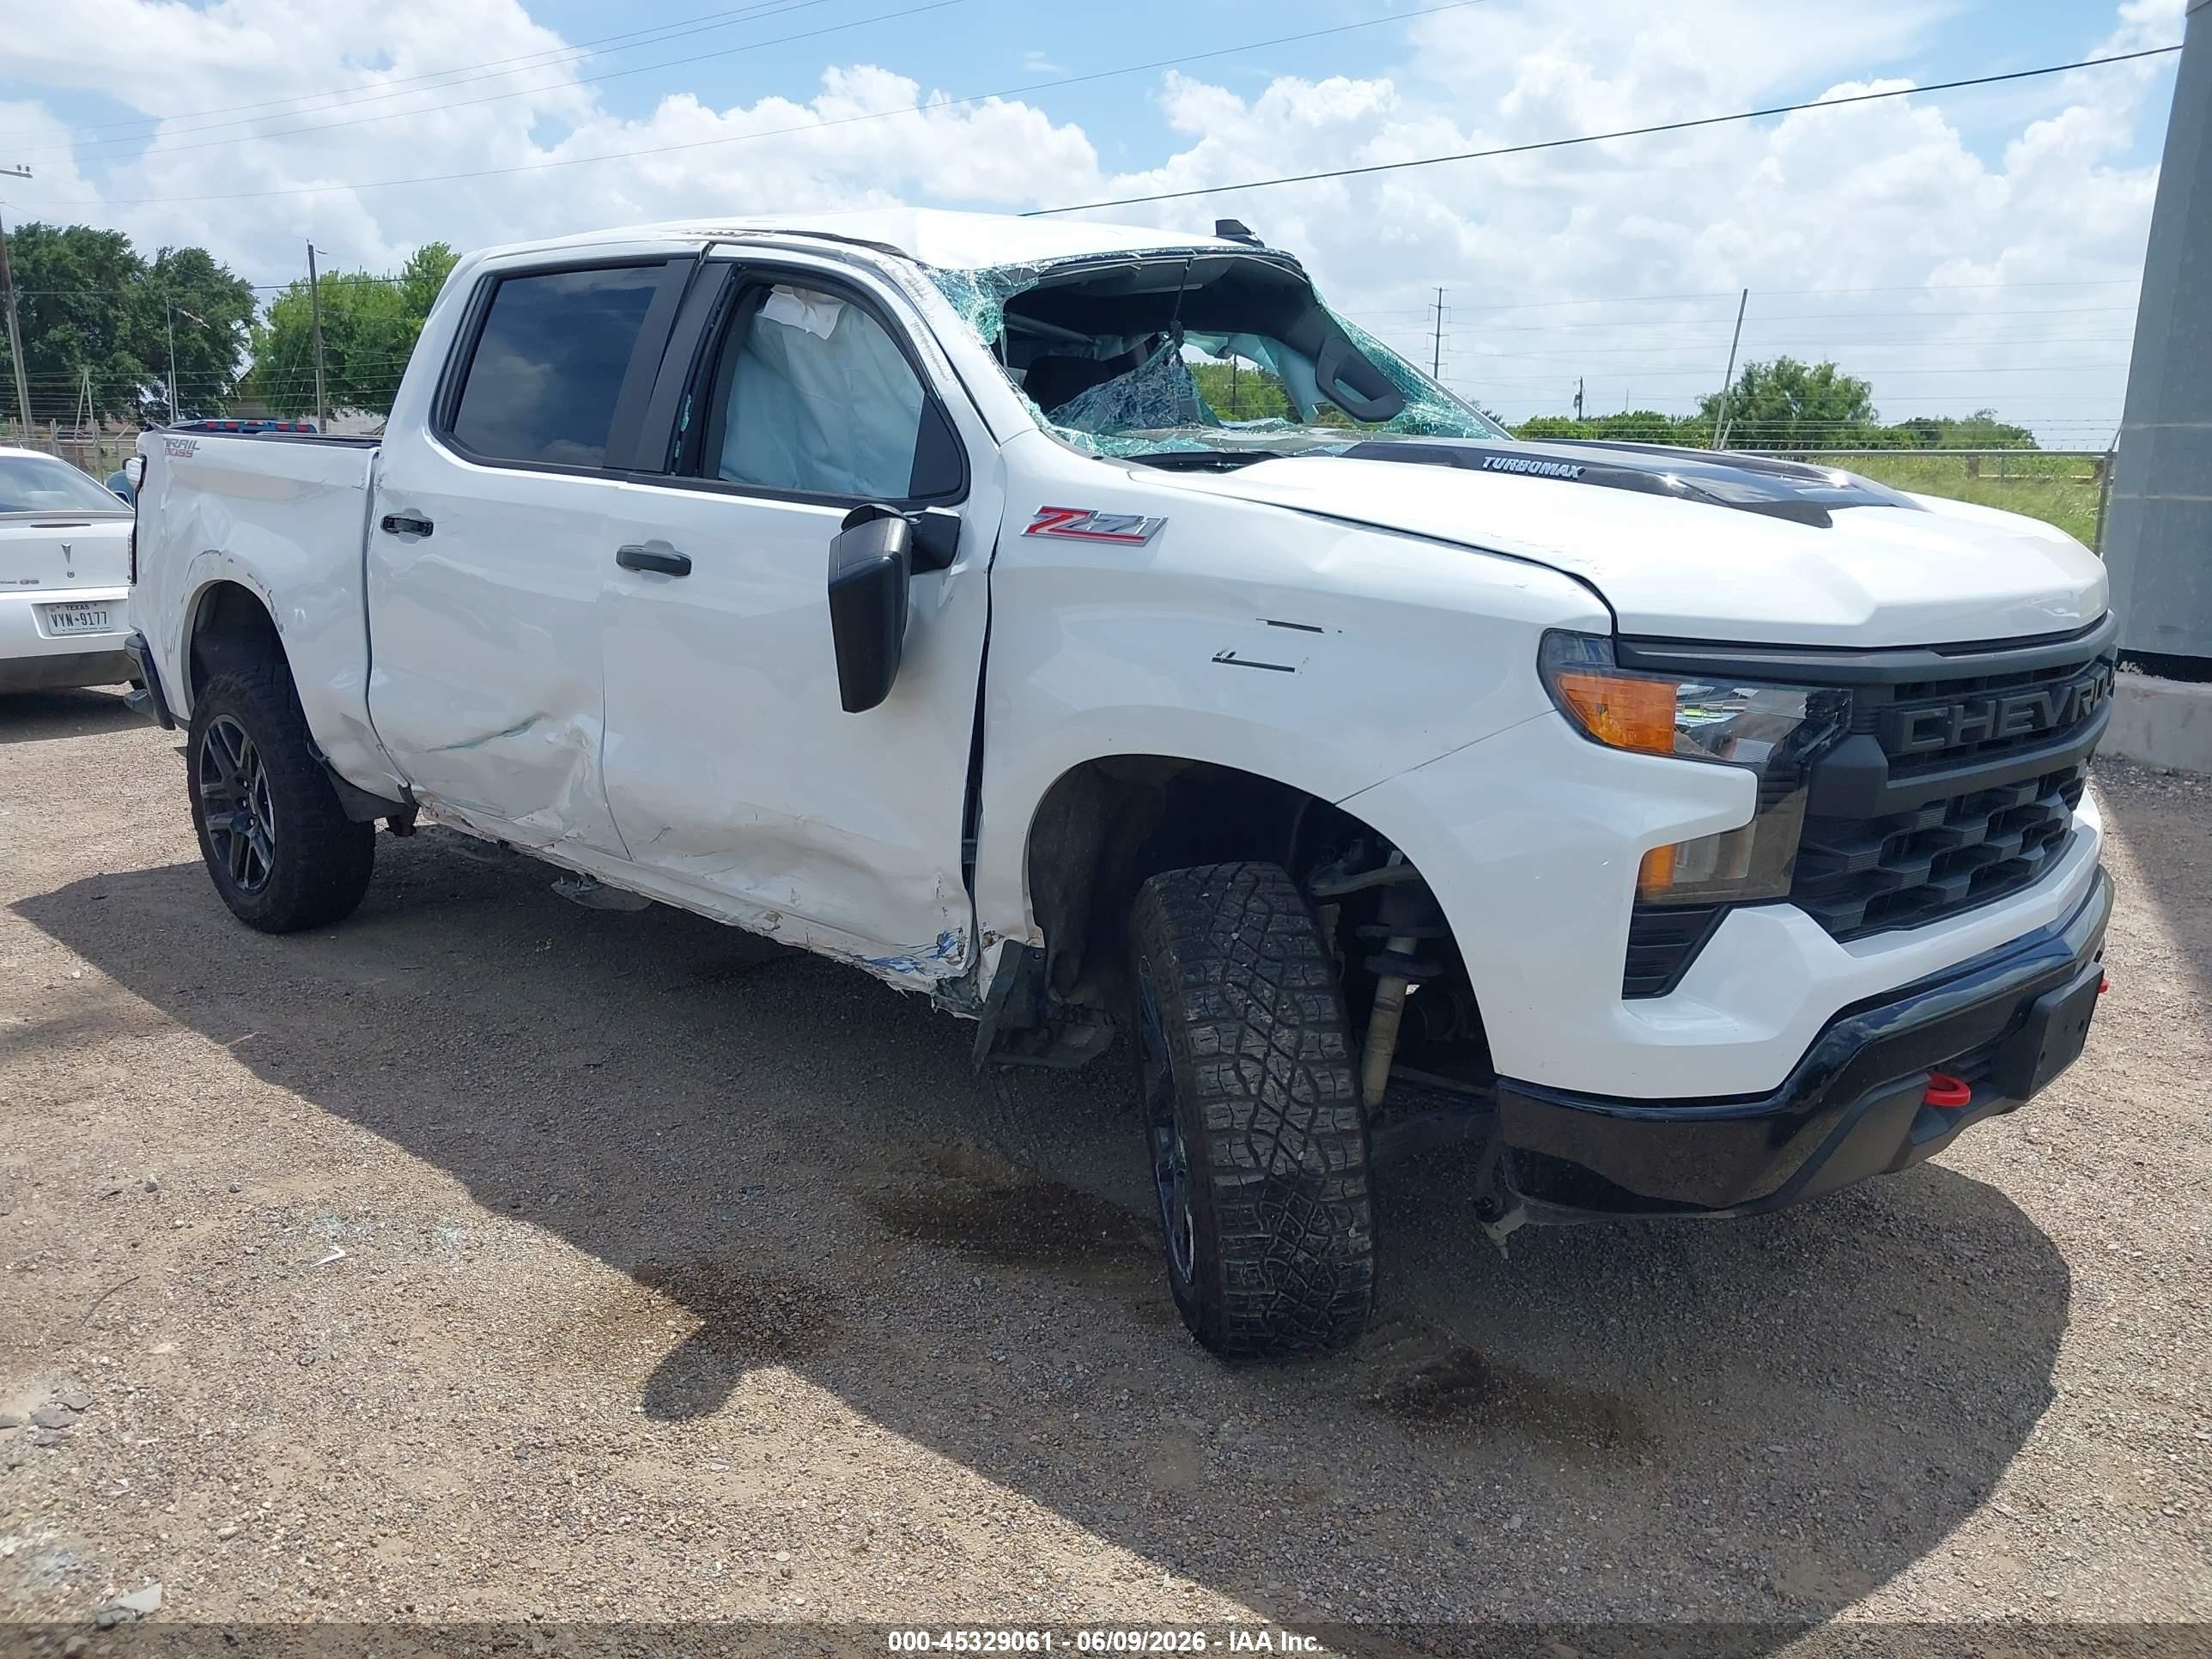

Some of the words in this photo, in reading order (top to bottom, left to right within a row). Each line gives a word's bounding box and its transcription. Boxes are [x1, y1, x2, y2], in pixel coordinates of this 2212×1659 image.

[163, 438, 200, 451] TRAIL
[1482, 456, 1585, 479] TURBOMAX
[1019, 505, 1169, 547] Z71
[1899, 665, 2115, 752] CHEVRO
